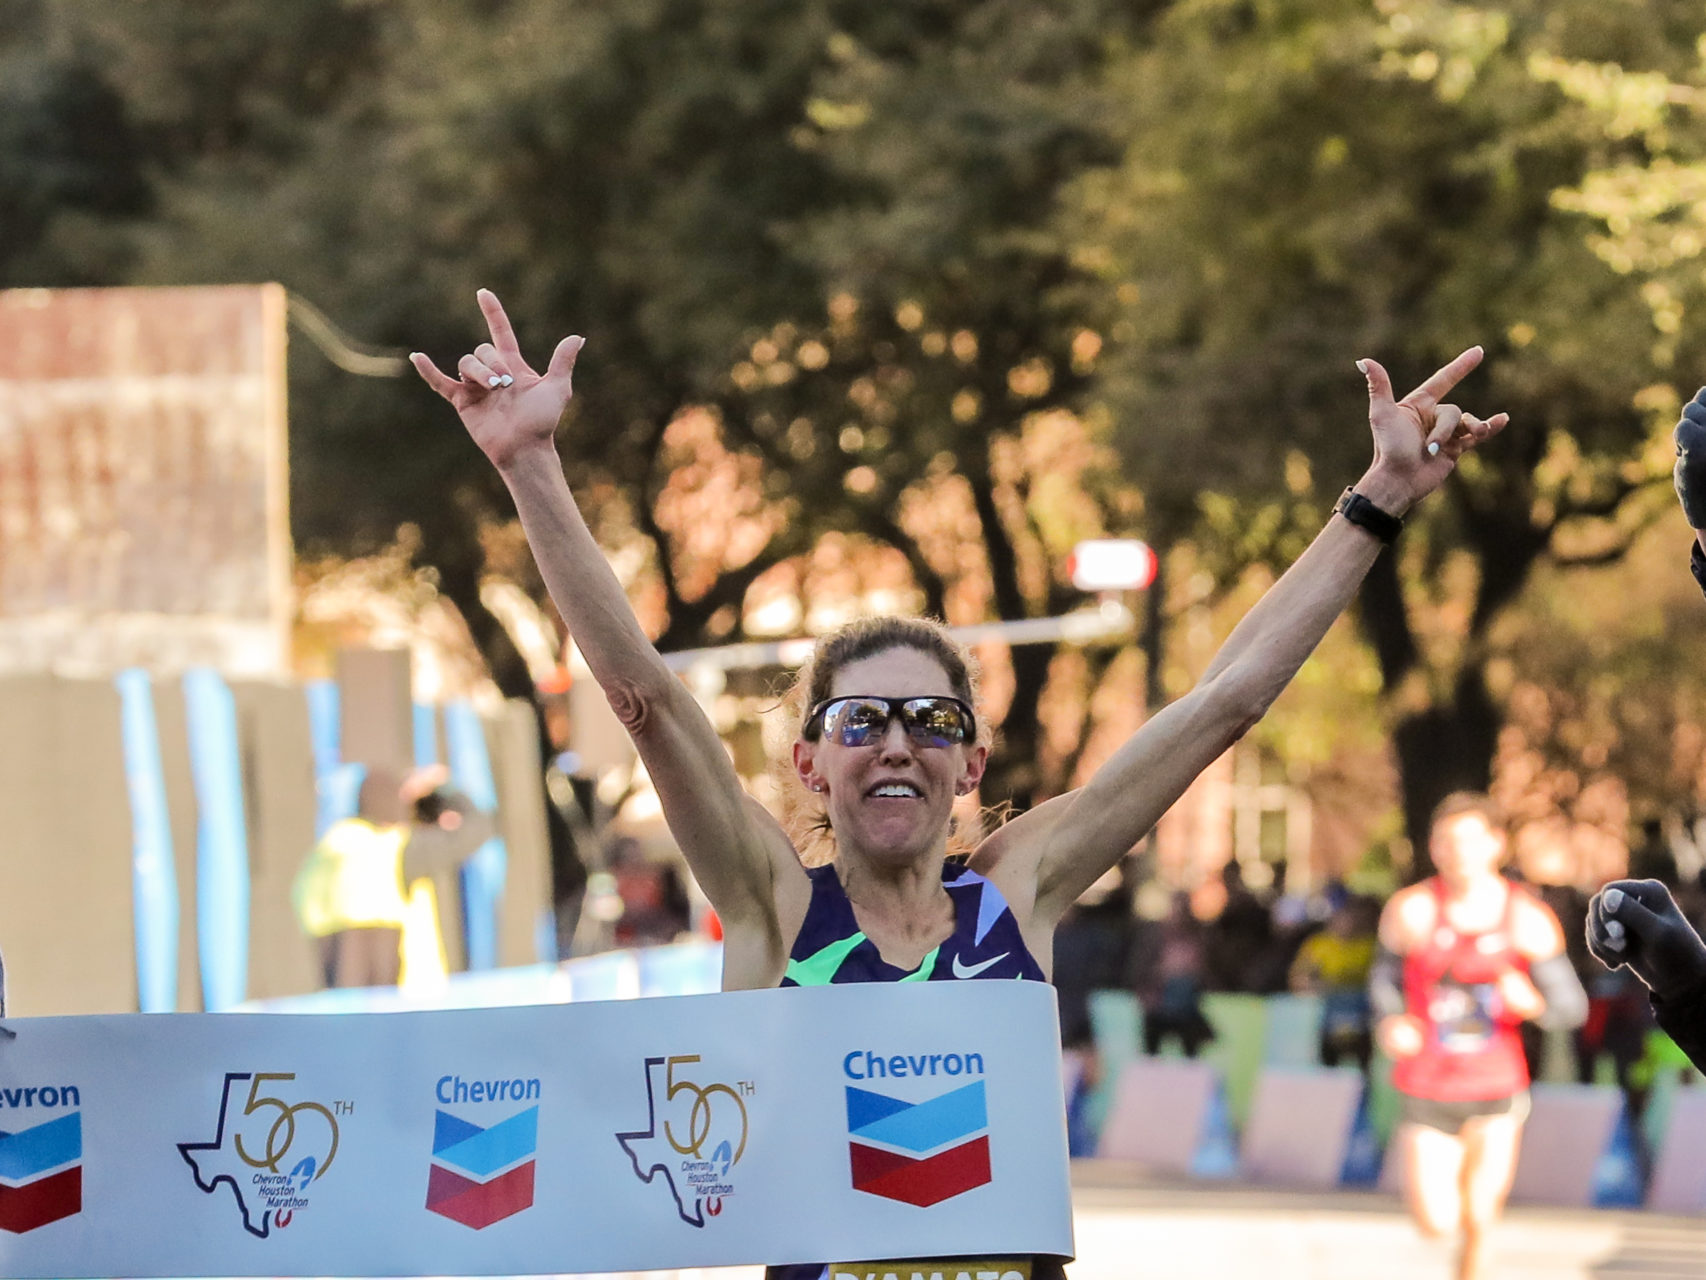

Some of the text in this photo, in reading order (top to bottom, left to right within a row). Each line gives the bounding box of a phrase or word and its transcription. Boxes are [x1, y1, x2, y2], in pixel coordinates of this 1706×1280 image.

[843, 1050, 984, 1080] Chevron
[435, 1075, 541, 1104] Chevron
[0, 1085, 80, 1108] vron
[681, 1160, 710, 1172] Chevron
[252, 1174, 287, 1185] Chevron
[687, 1172, 718, 1183] Houston
[258, 1185, 295, 1196] Houston
[695, 1183, 733, 1195] Marathon
[266, 1197, 308, 1208] Marathon
